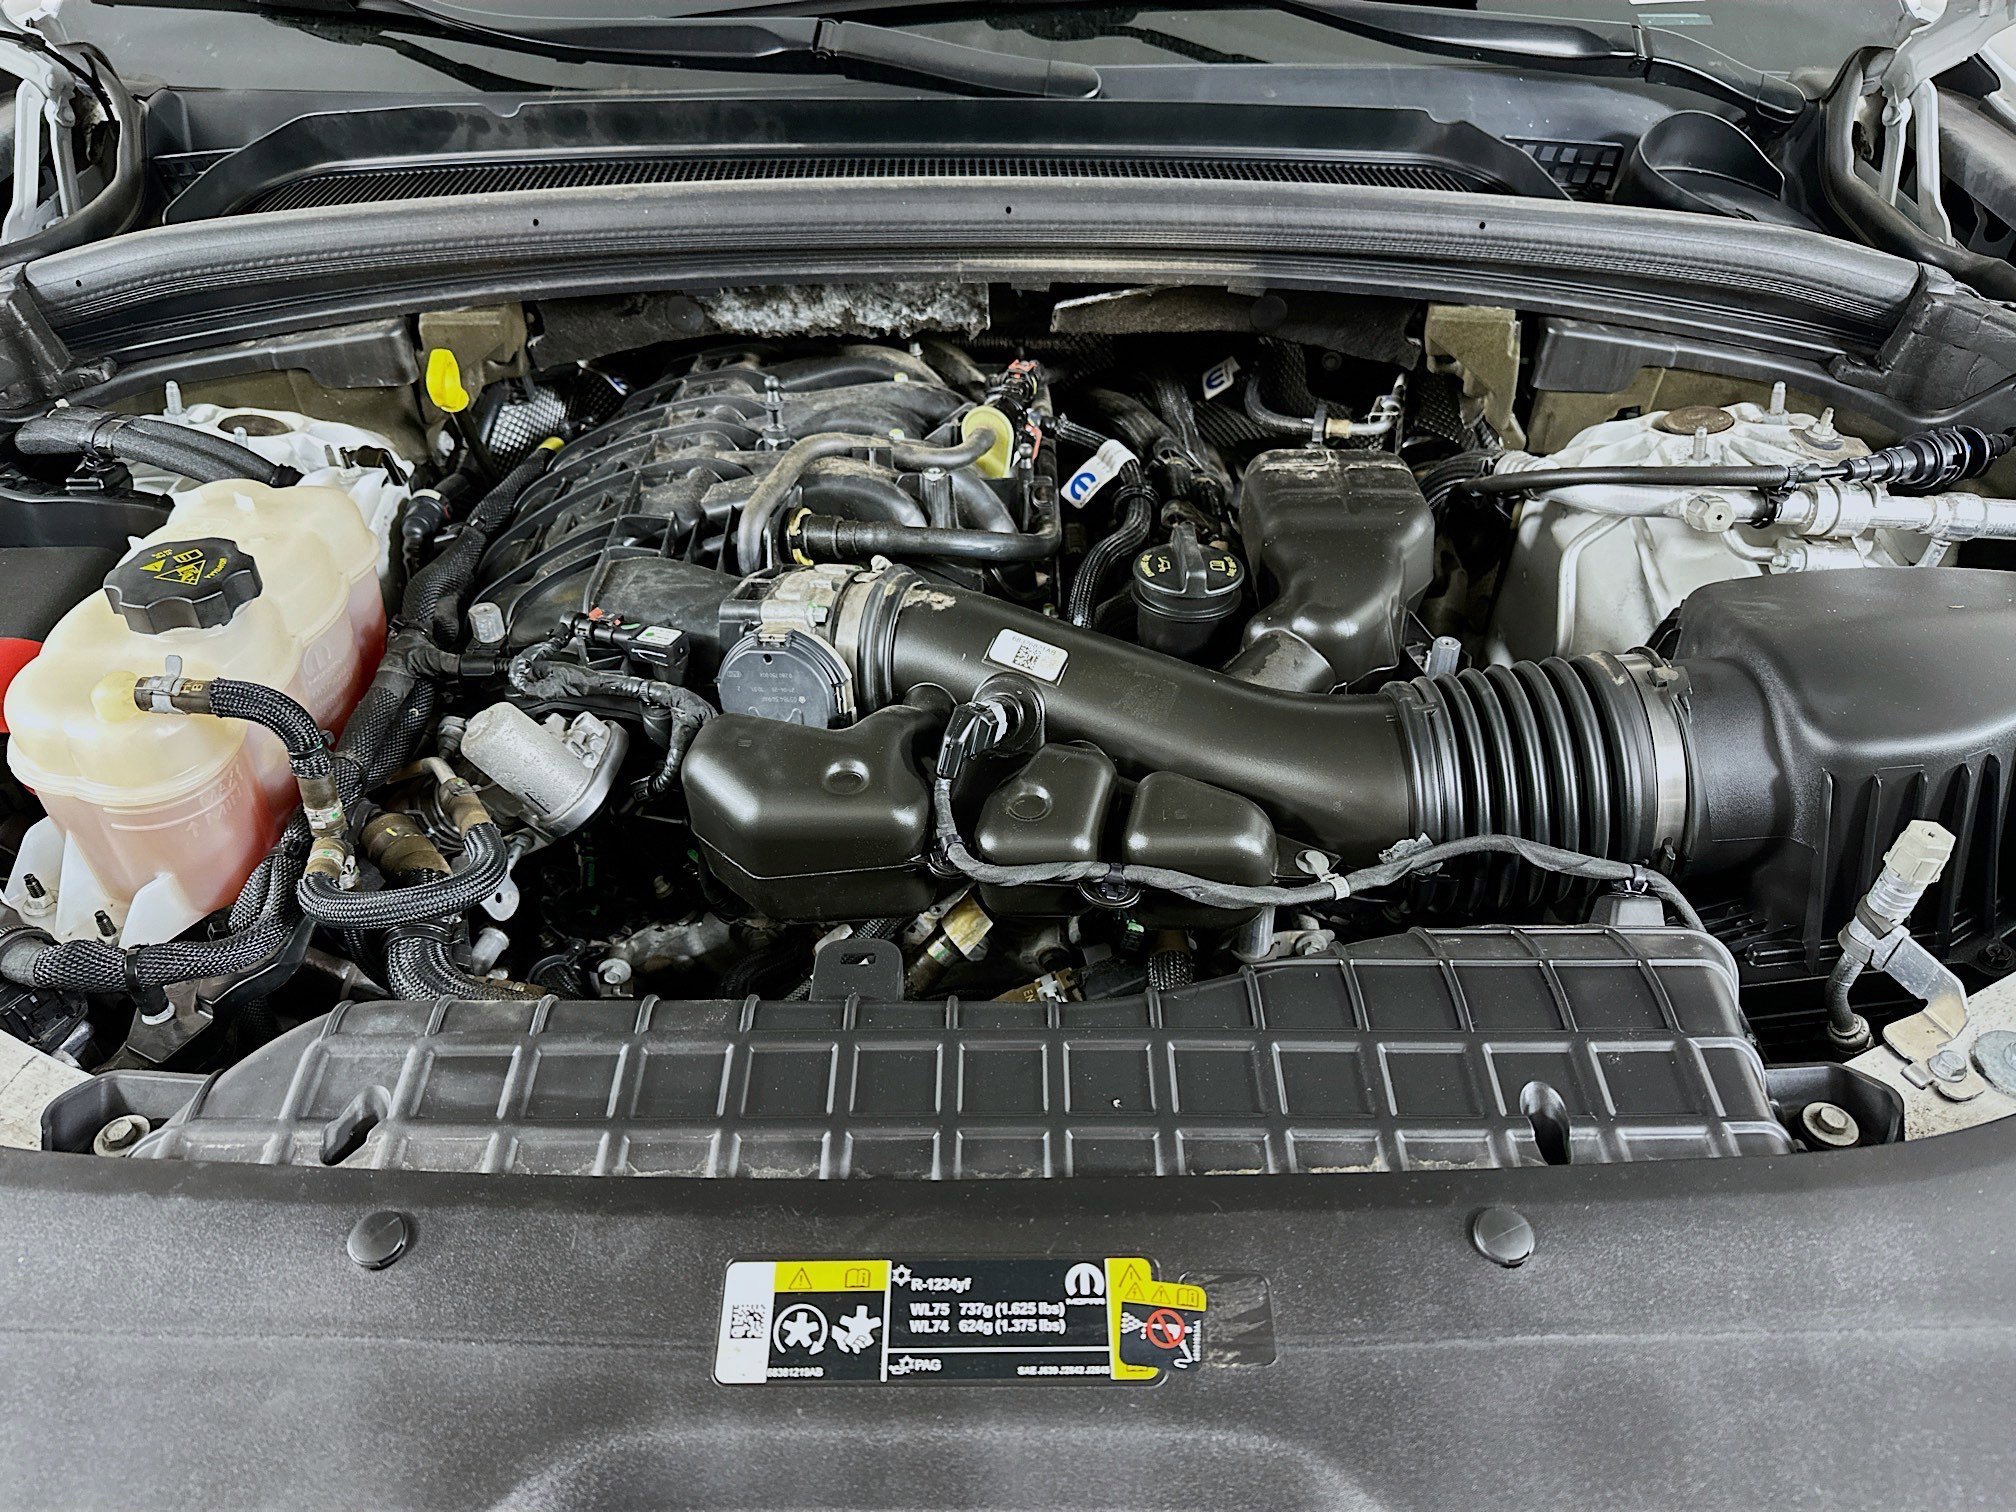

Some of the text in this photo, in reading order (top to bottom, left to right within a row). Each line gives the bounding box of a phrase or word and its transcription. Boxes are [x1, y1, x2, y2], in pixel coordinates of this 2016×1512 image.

[911, 1277, 972, 1294] R-1234yf
[909, 1302, 1065, 1318] WL75 737g (1.625 lbs)
[909, 1319, 1066, 1335] WL74 624g (1.375 lbs)
[914, 1359, 941, 1371] PAG
